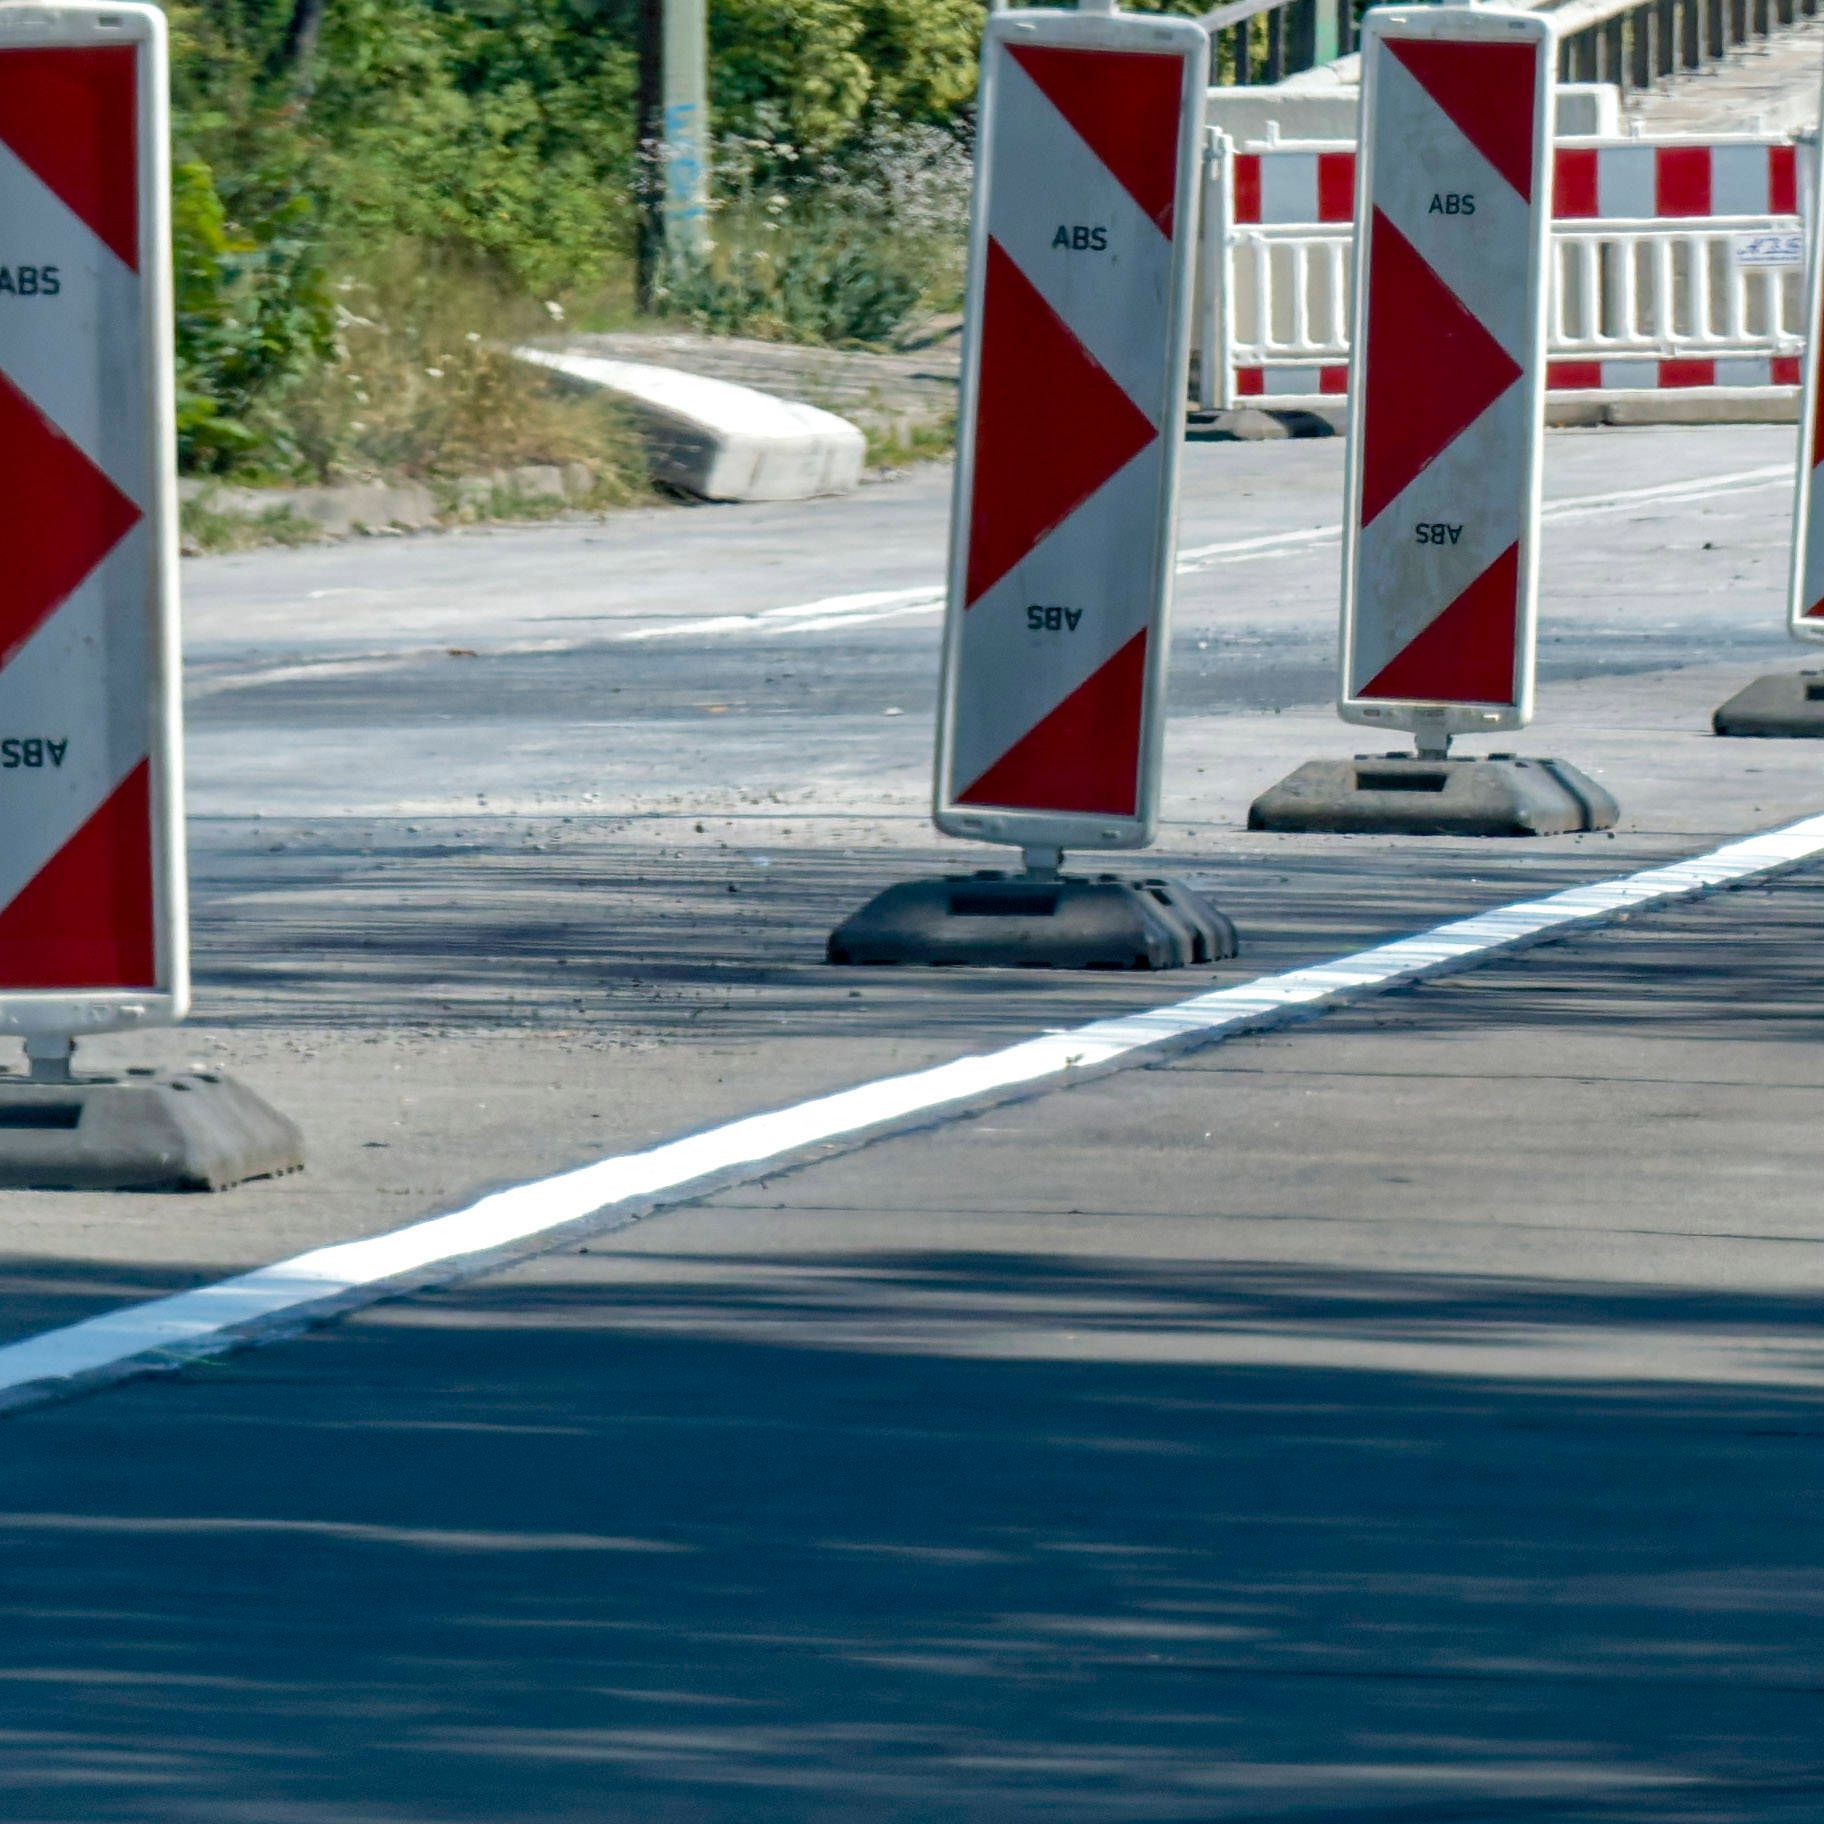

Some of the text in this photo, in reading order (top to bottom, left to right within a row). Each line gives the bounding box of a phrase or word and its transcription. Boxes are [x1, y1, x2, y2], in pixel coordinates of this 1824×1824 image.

[1428, 193, 1476, 216] ABS
[1051, 224, 1108, 252] ABS
[0, 265, 61, 296] ABS
[1415, 522, 1465, 546] ABS
[1026, 604, 1083, 632] ABS
[1, 738, 68, 769] ABS
